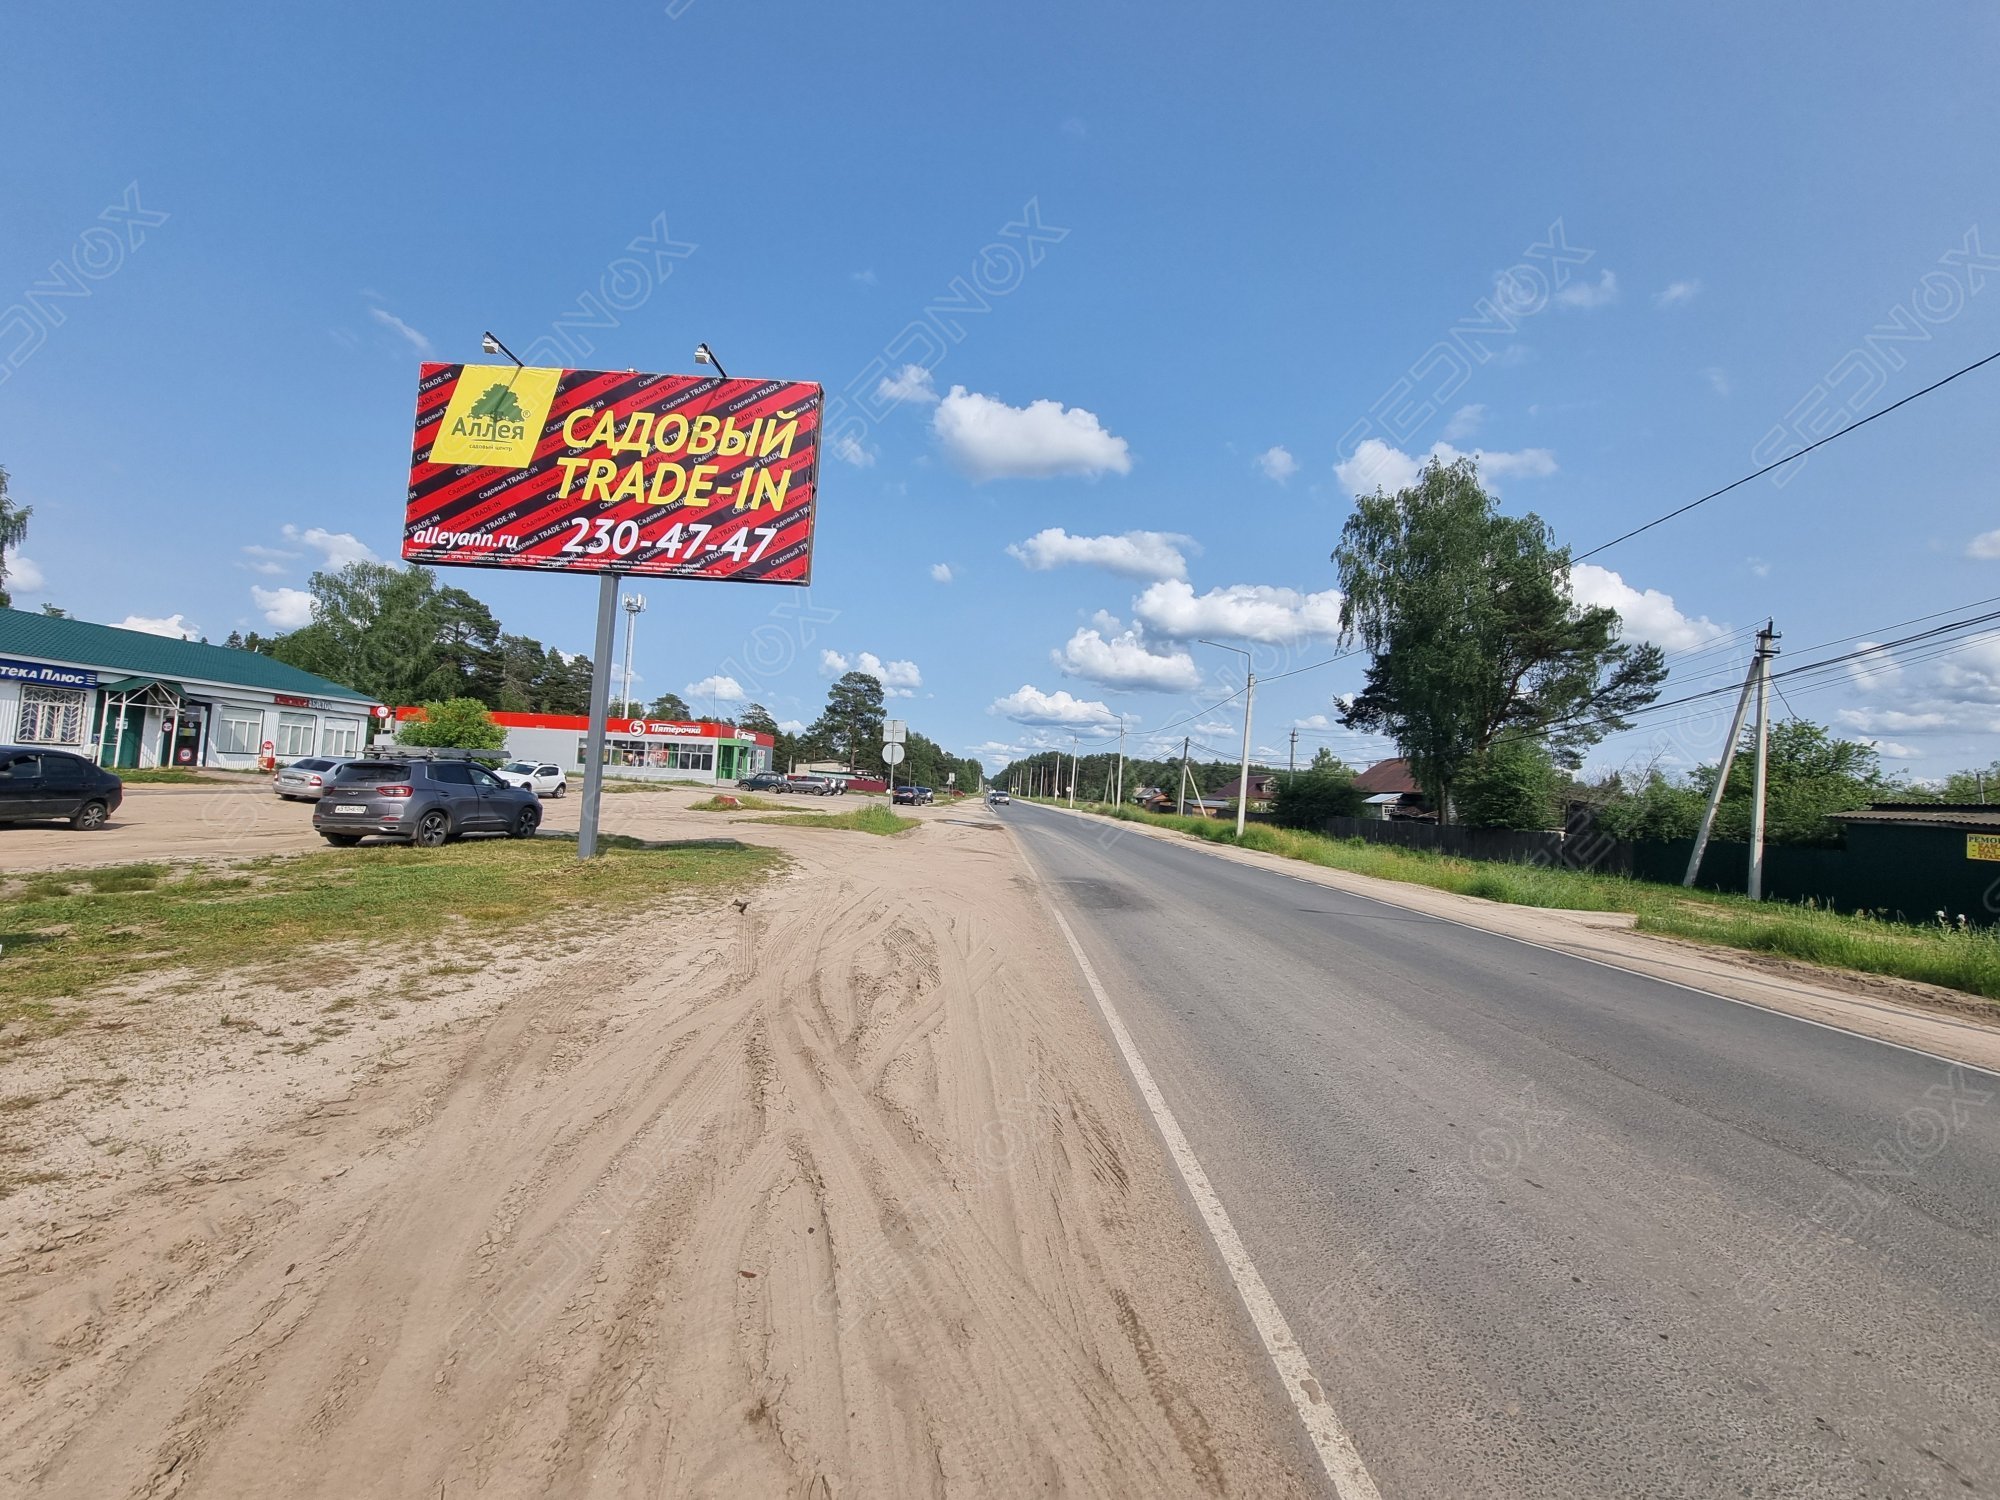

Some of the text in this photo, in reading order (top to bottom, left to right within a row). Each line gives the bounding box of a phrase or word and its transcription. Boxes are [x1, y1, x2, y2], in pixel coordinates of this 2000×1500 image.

[421, 372, 452, 391] TRADE-IN
[661, 393, 690, 411] Садовый
[690, 377, 720, 397] TRADE-IN
[729, 394, 758, 412] Садовый
[416, 410, 444, 427] Садовый
[451, 417, 525, 441] Аллея
[562, 408, 798, 459] САДОВЫЙ
[479, 466, 538, 499] Садовый TRADE-IN
[557, 457, 792, 511] TRADE-IN
[409, 514, 440, 534] TRADE-IN
[485, 511, 517, 530] TRADE-IN
[638, 505, 666, 525] Садовый
[413, 527, 519, 549] alleyann.ru
[539, 521, 570, 540] TRADE-IN
[562, 517, 777, 563] 230-47-47
[771, 548, 800, 566] Садовый
